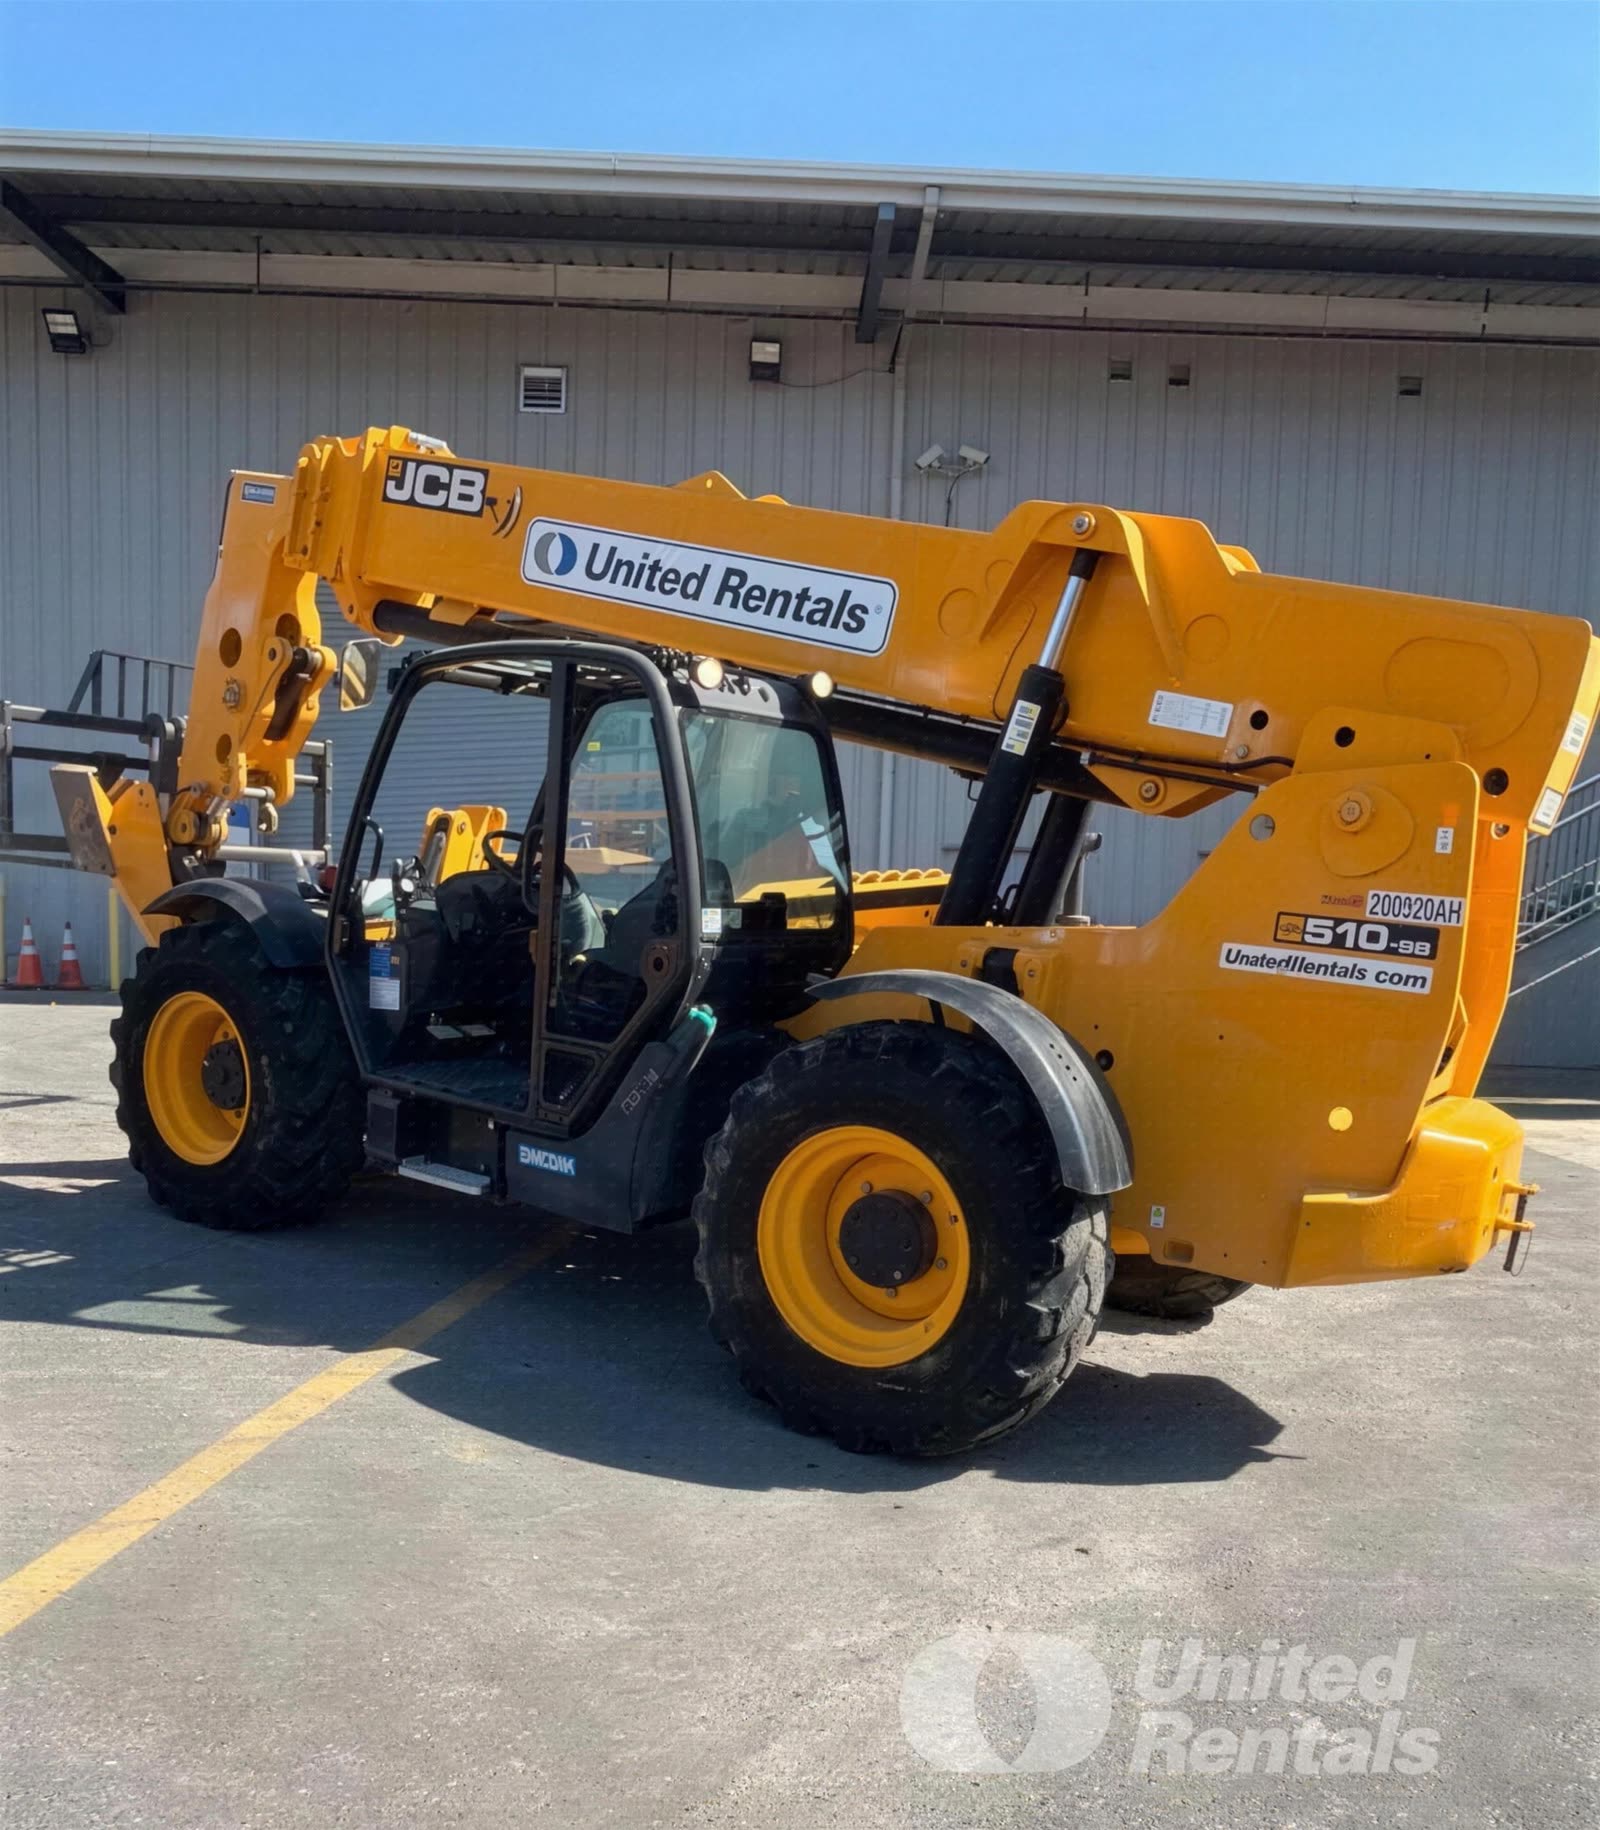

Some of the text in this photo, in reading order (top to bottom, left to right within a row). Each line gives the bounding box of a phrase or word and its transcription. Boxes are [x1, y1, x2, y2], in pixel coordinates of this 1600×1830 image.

[386, 461, 485, 512] JCB
[584, 542, 871, 634] United Rentals
